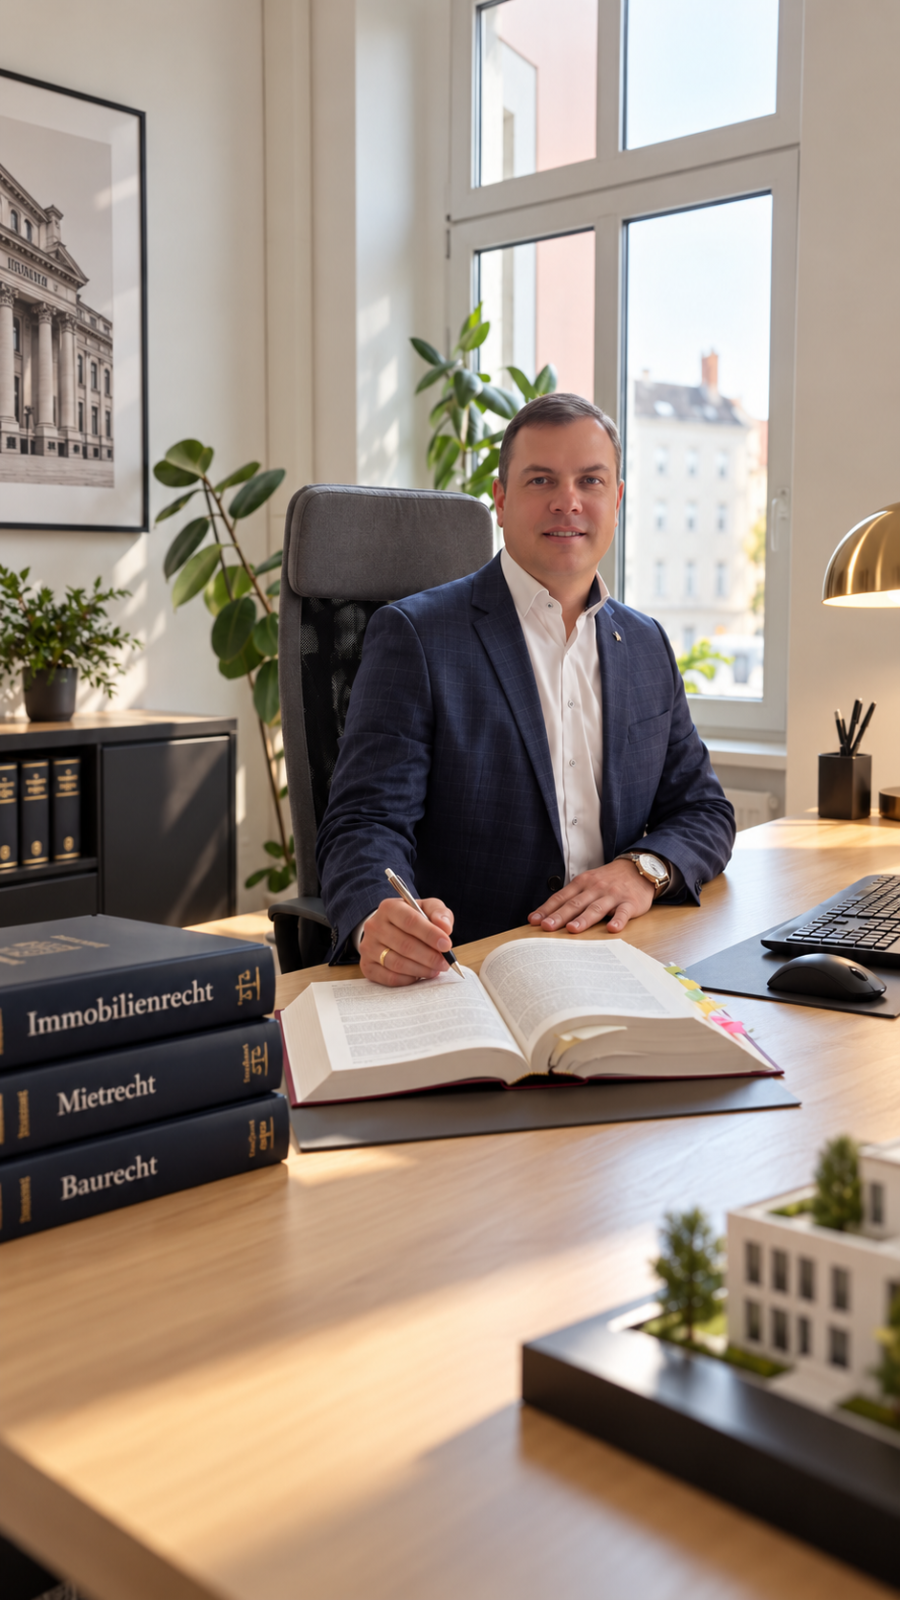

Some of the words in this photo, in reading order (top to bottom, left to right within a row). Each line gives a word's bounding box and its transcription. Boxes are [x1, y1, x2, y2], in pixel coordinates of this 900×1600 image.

[28, 980, 214, 1036] Immobilienrecht
[57, 1074, 156, 1116] Mietrecht
[61, 1156, 158, 1200] Baurecht
